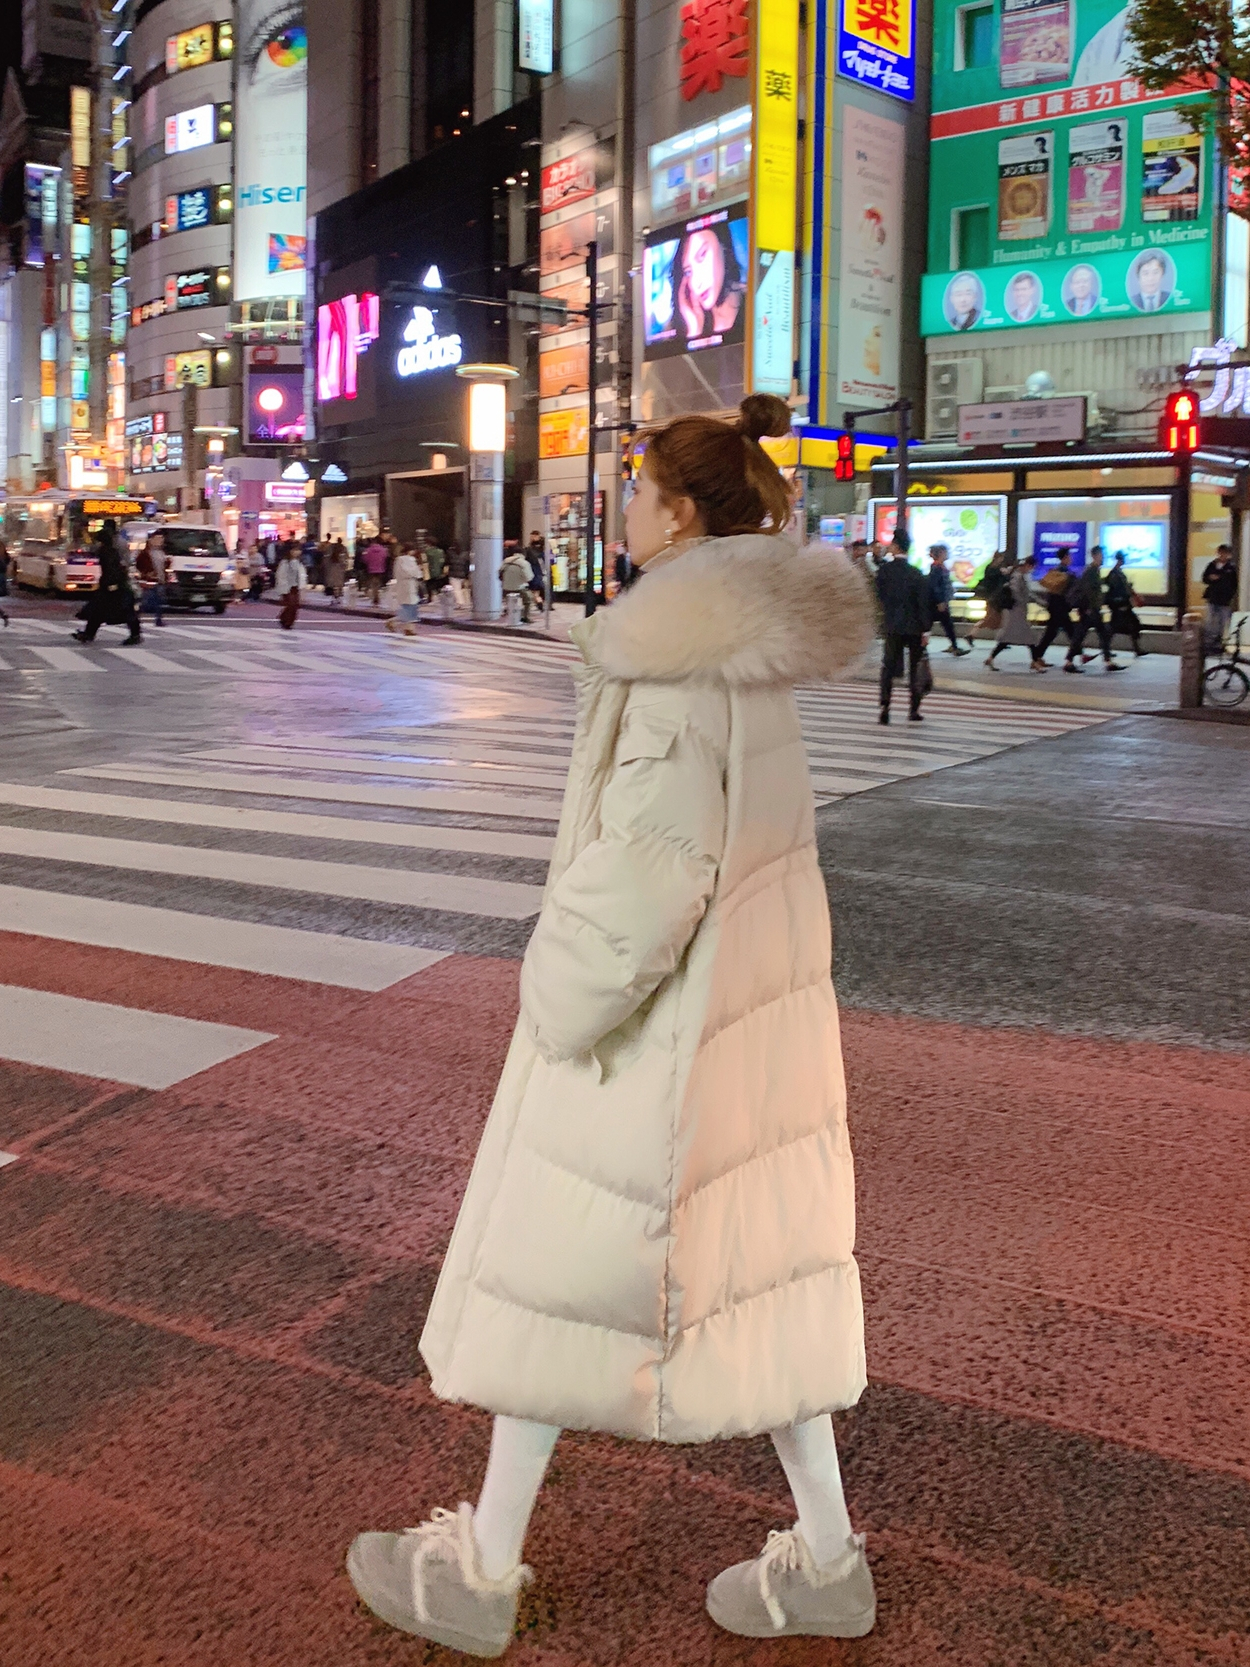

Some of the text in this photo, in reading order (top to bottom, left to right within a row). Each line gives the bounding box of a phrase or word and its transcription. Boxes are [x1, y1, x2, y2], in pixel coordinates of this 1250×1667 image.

[764, 70, 792, 101] 薬
[993, 226, 1209, 263] Humanity & Empathy in Medicine
[397, 333, 462, 376] adidas
